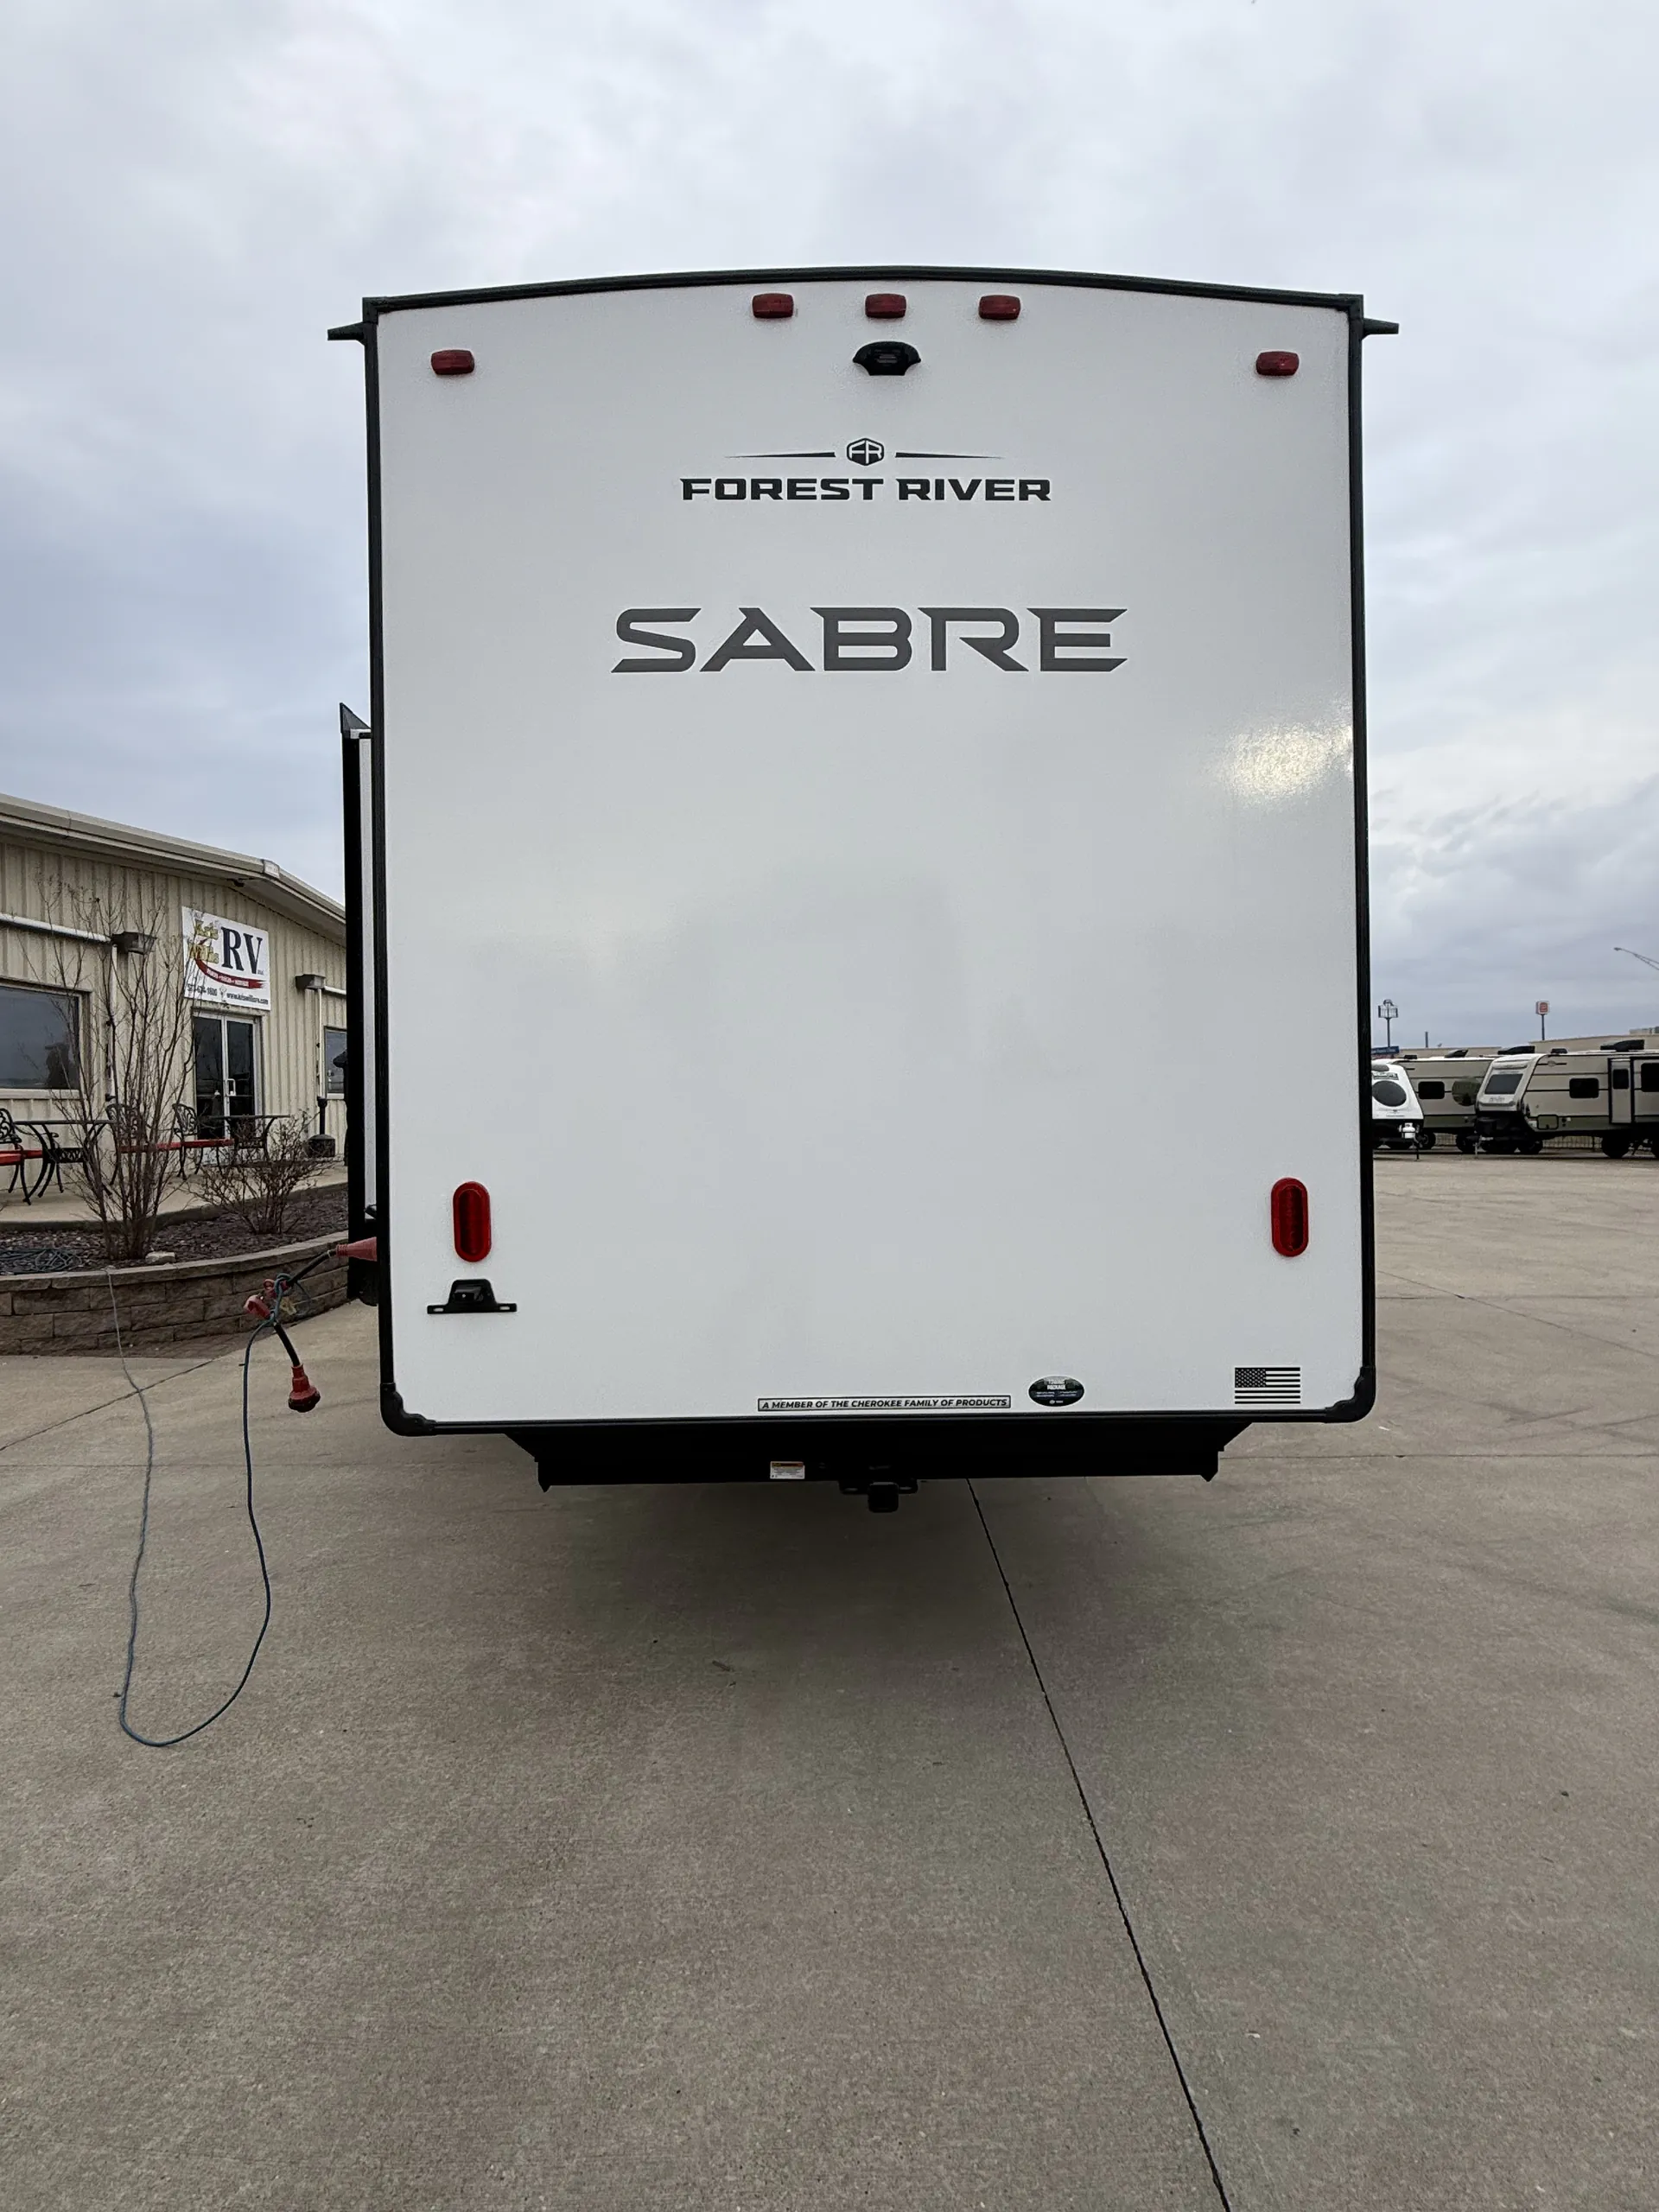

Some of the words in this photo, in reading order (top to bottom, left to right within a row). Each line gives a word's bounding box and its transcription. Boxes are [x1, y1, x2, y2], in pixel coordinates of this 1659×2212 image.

[680, 478, 884, 501] FOREST
[895, 478, 1052, 501] RIVER
[611, 607, 1128, 673] SABRE
[220, 926, 263, 975] RV
[955, 1398, 1007, 1407] PRODUCTS
